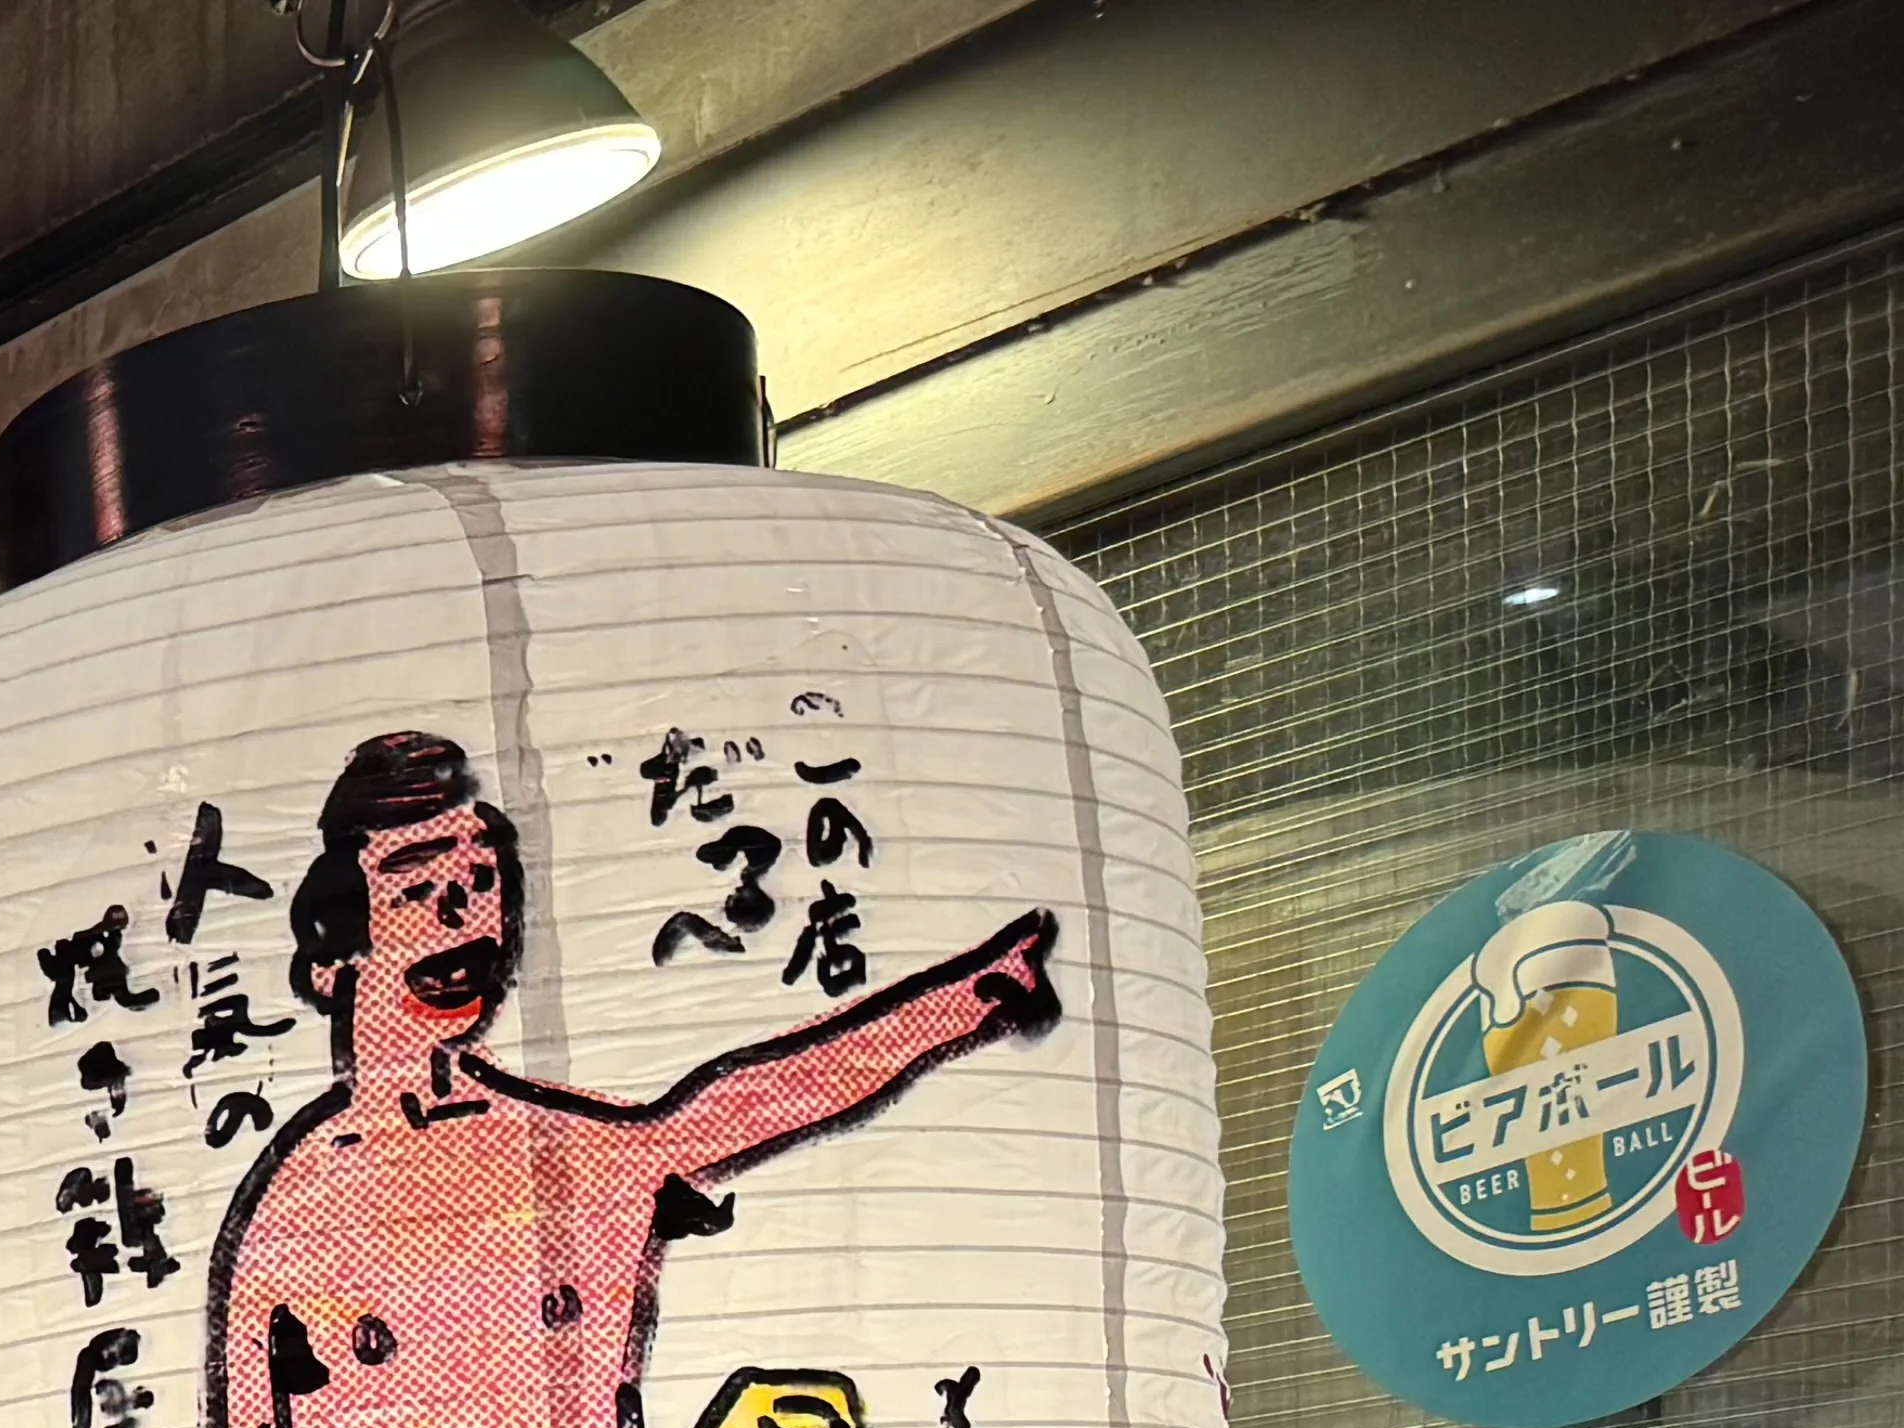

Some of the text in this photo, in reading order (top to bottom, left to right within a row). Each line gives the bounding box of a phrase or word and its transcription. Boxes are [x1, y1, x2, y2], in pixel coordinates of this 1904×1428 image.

[1429, 1033, 1697, 1165] ビアボール
[1458, 1130, 1674, 1206] BEER BALL
[1686, 1149, 1741, 1245] ビール
[1436, 1258, 1744, 1383] サントリー謹製
